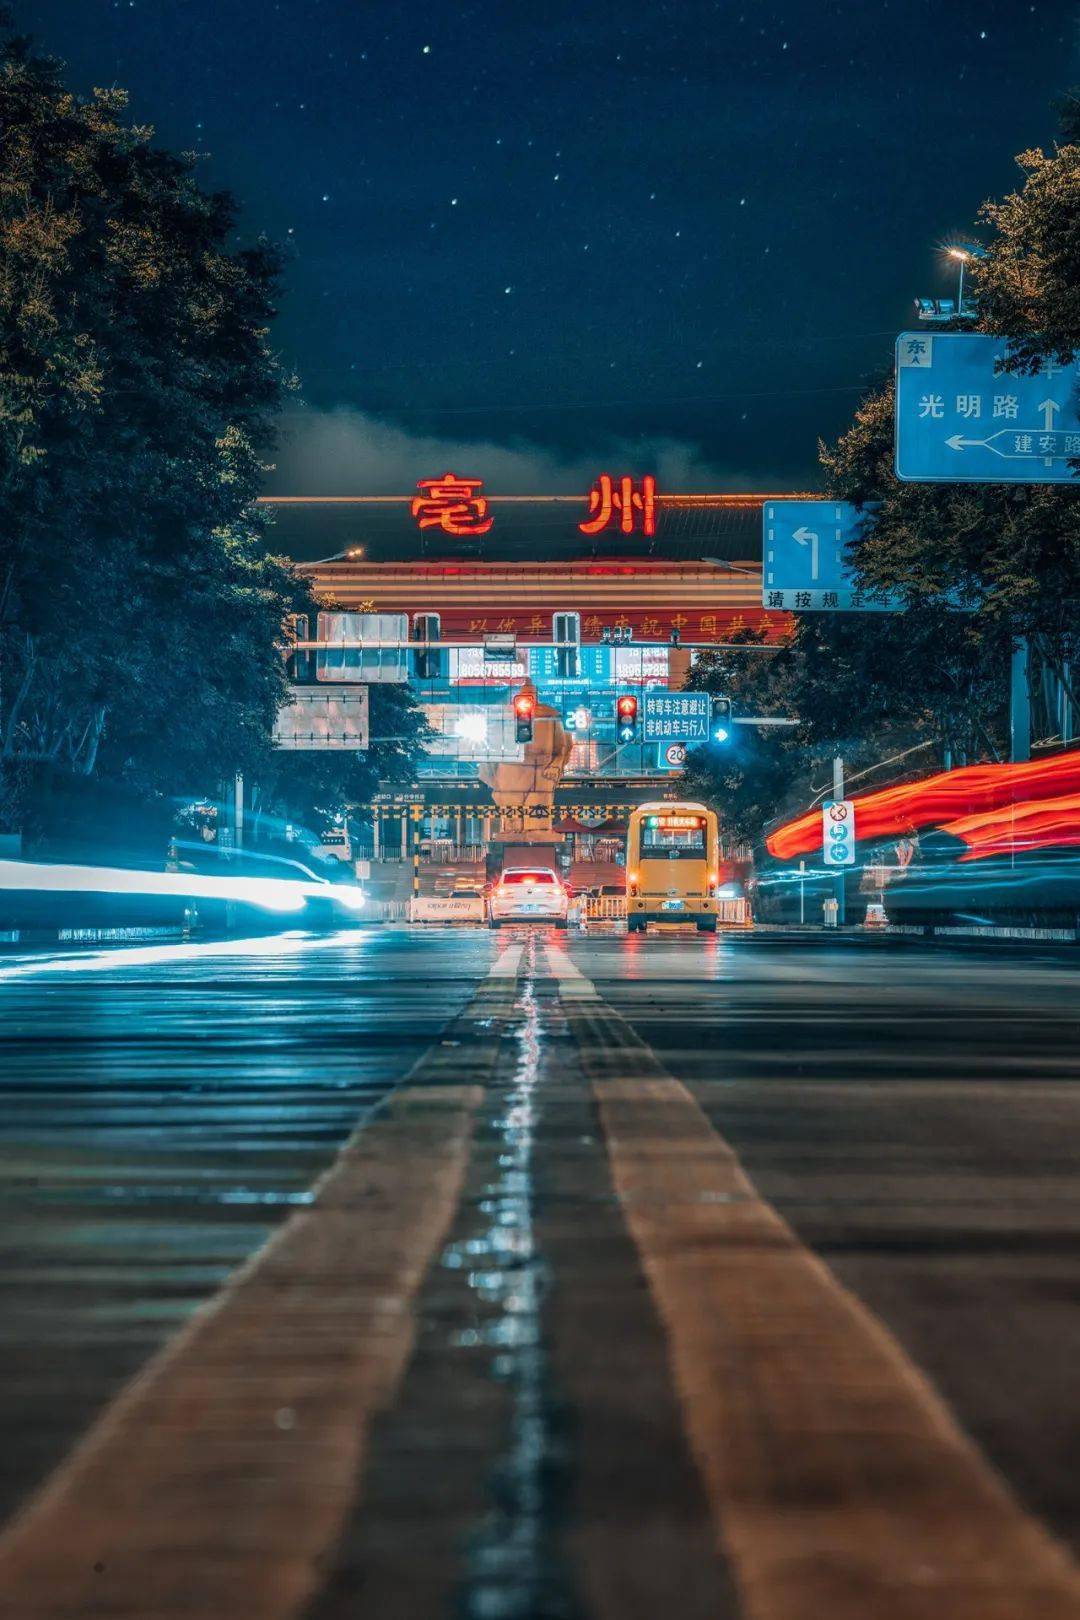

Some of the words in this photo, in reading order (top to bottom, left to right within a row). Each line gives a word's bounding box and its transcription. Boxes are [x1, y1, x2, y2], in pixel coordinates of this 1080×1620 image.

[907, 339, 926, 354] 东
[918, 394, 1019, 419] 光明路
[1014, 435, 1080, 454] 建安路
[647, 698, 706, 715] 转弯车注意避让
[647, 720, 706, 736] 非机动车与行人
[670, 749, 684, 761] 20
